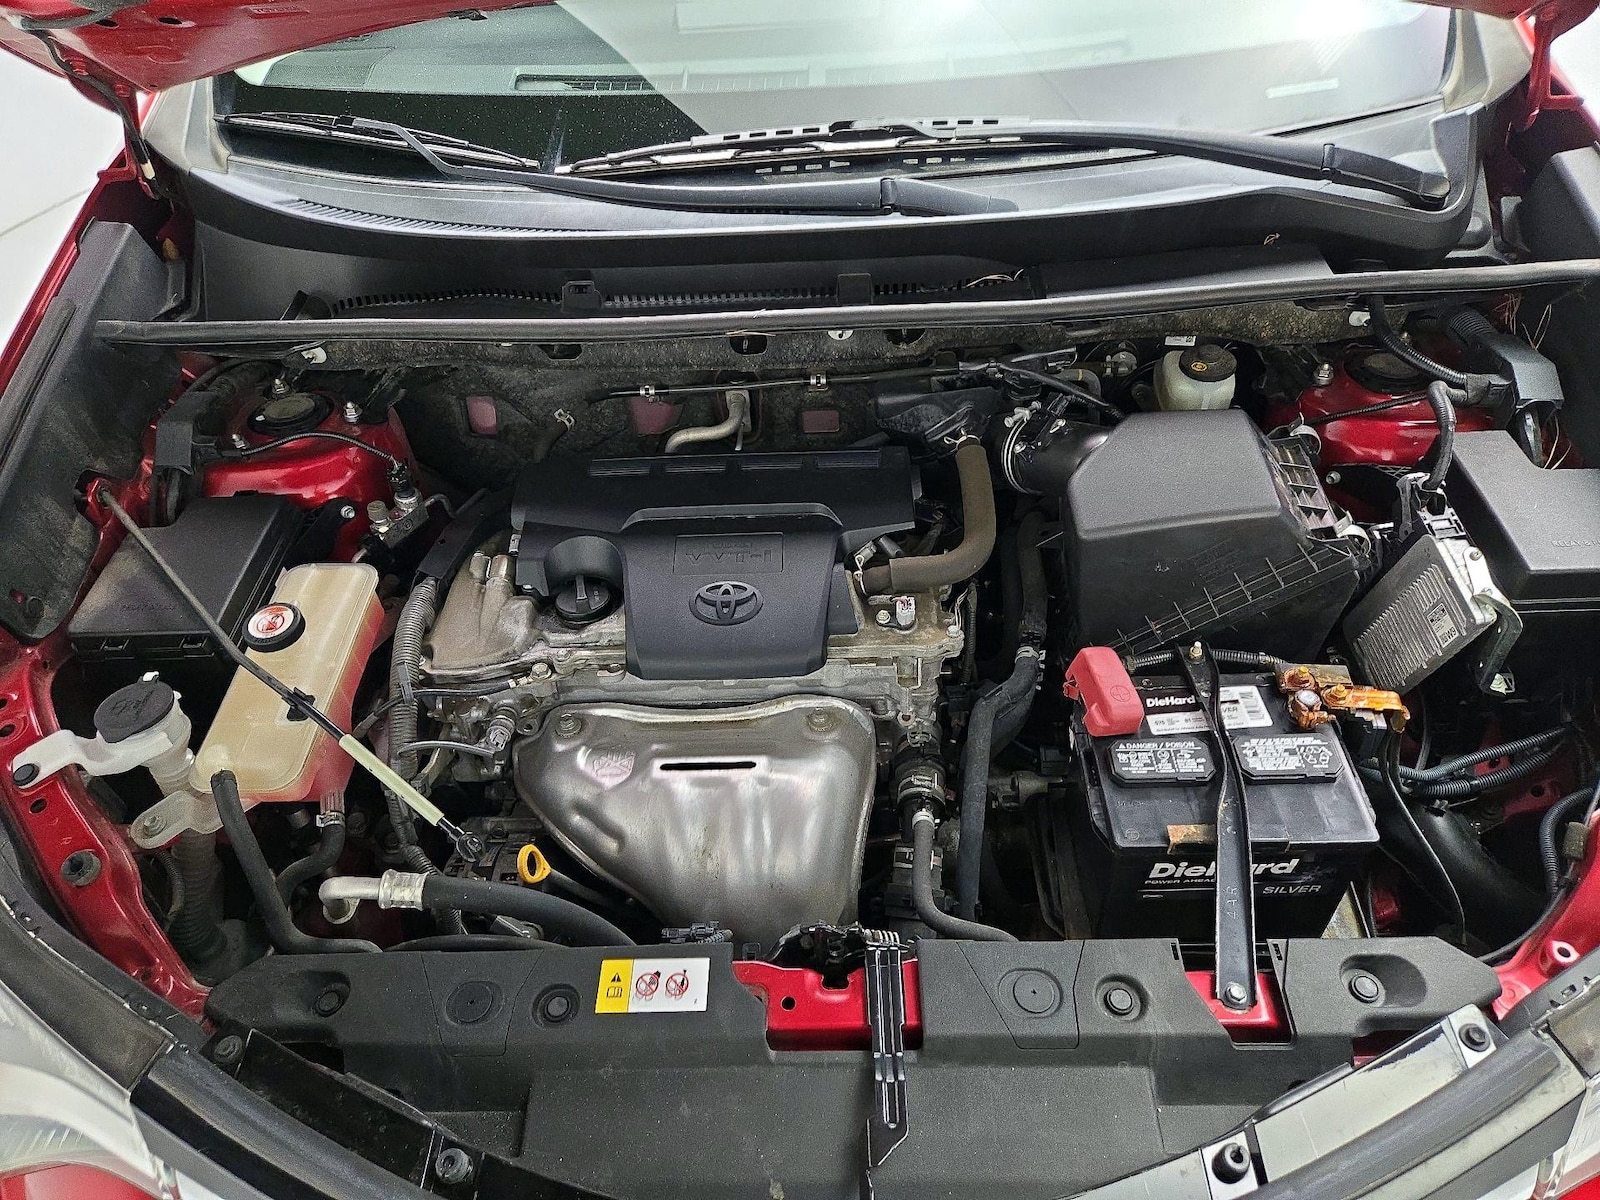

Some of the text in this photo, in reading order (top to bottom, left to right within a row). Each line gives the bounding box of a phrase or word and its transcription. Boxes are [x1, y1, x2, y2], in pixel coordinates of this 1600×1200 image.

[1146, 694, 1196, 708] DieHard
[1126, 742, 1158, 750] DANGER
[1165, 741, 1195, 749] POISON
[1262, 884, 1322, 895] SILVER
